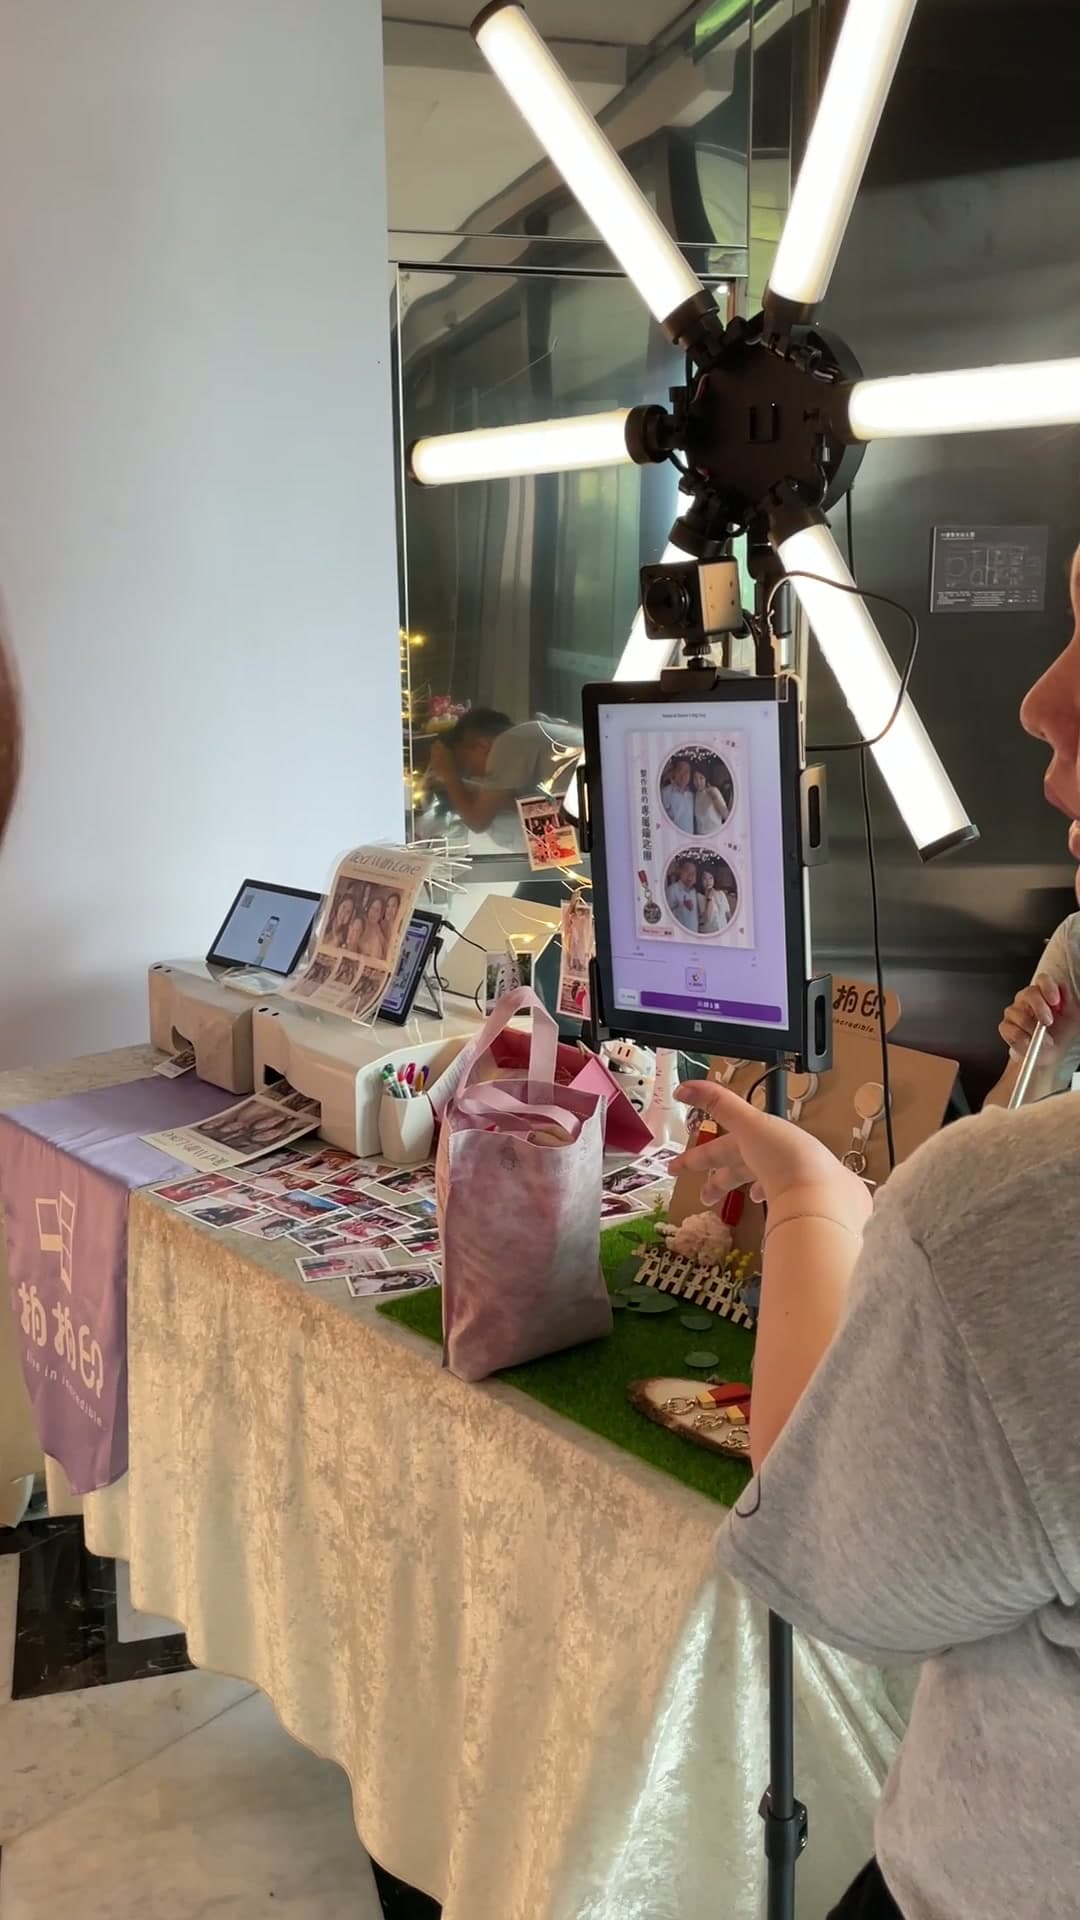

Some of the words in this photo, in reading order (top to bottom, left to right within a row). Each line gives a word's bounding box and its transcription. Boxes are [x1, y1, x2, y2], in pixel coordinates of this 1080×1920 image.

[18, 1281, 104, 1399] 拍拍印
[44, 1364, 57, 1381] in
